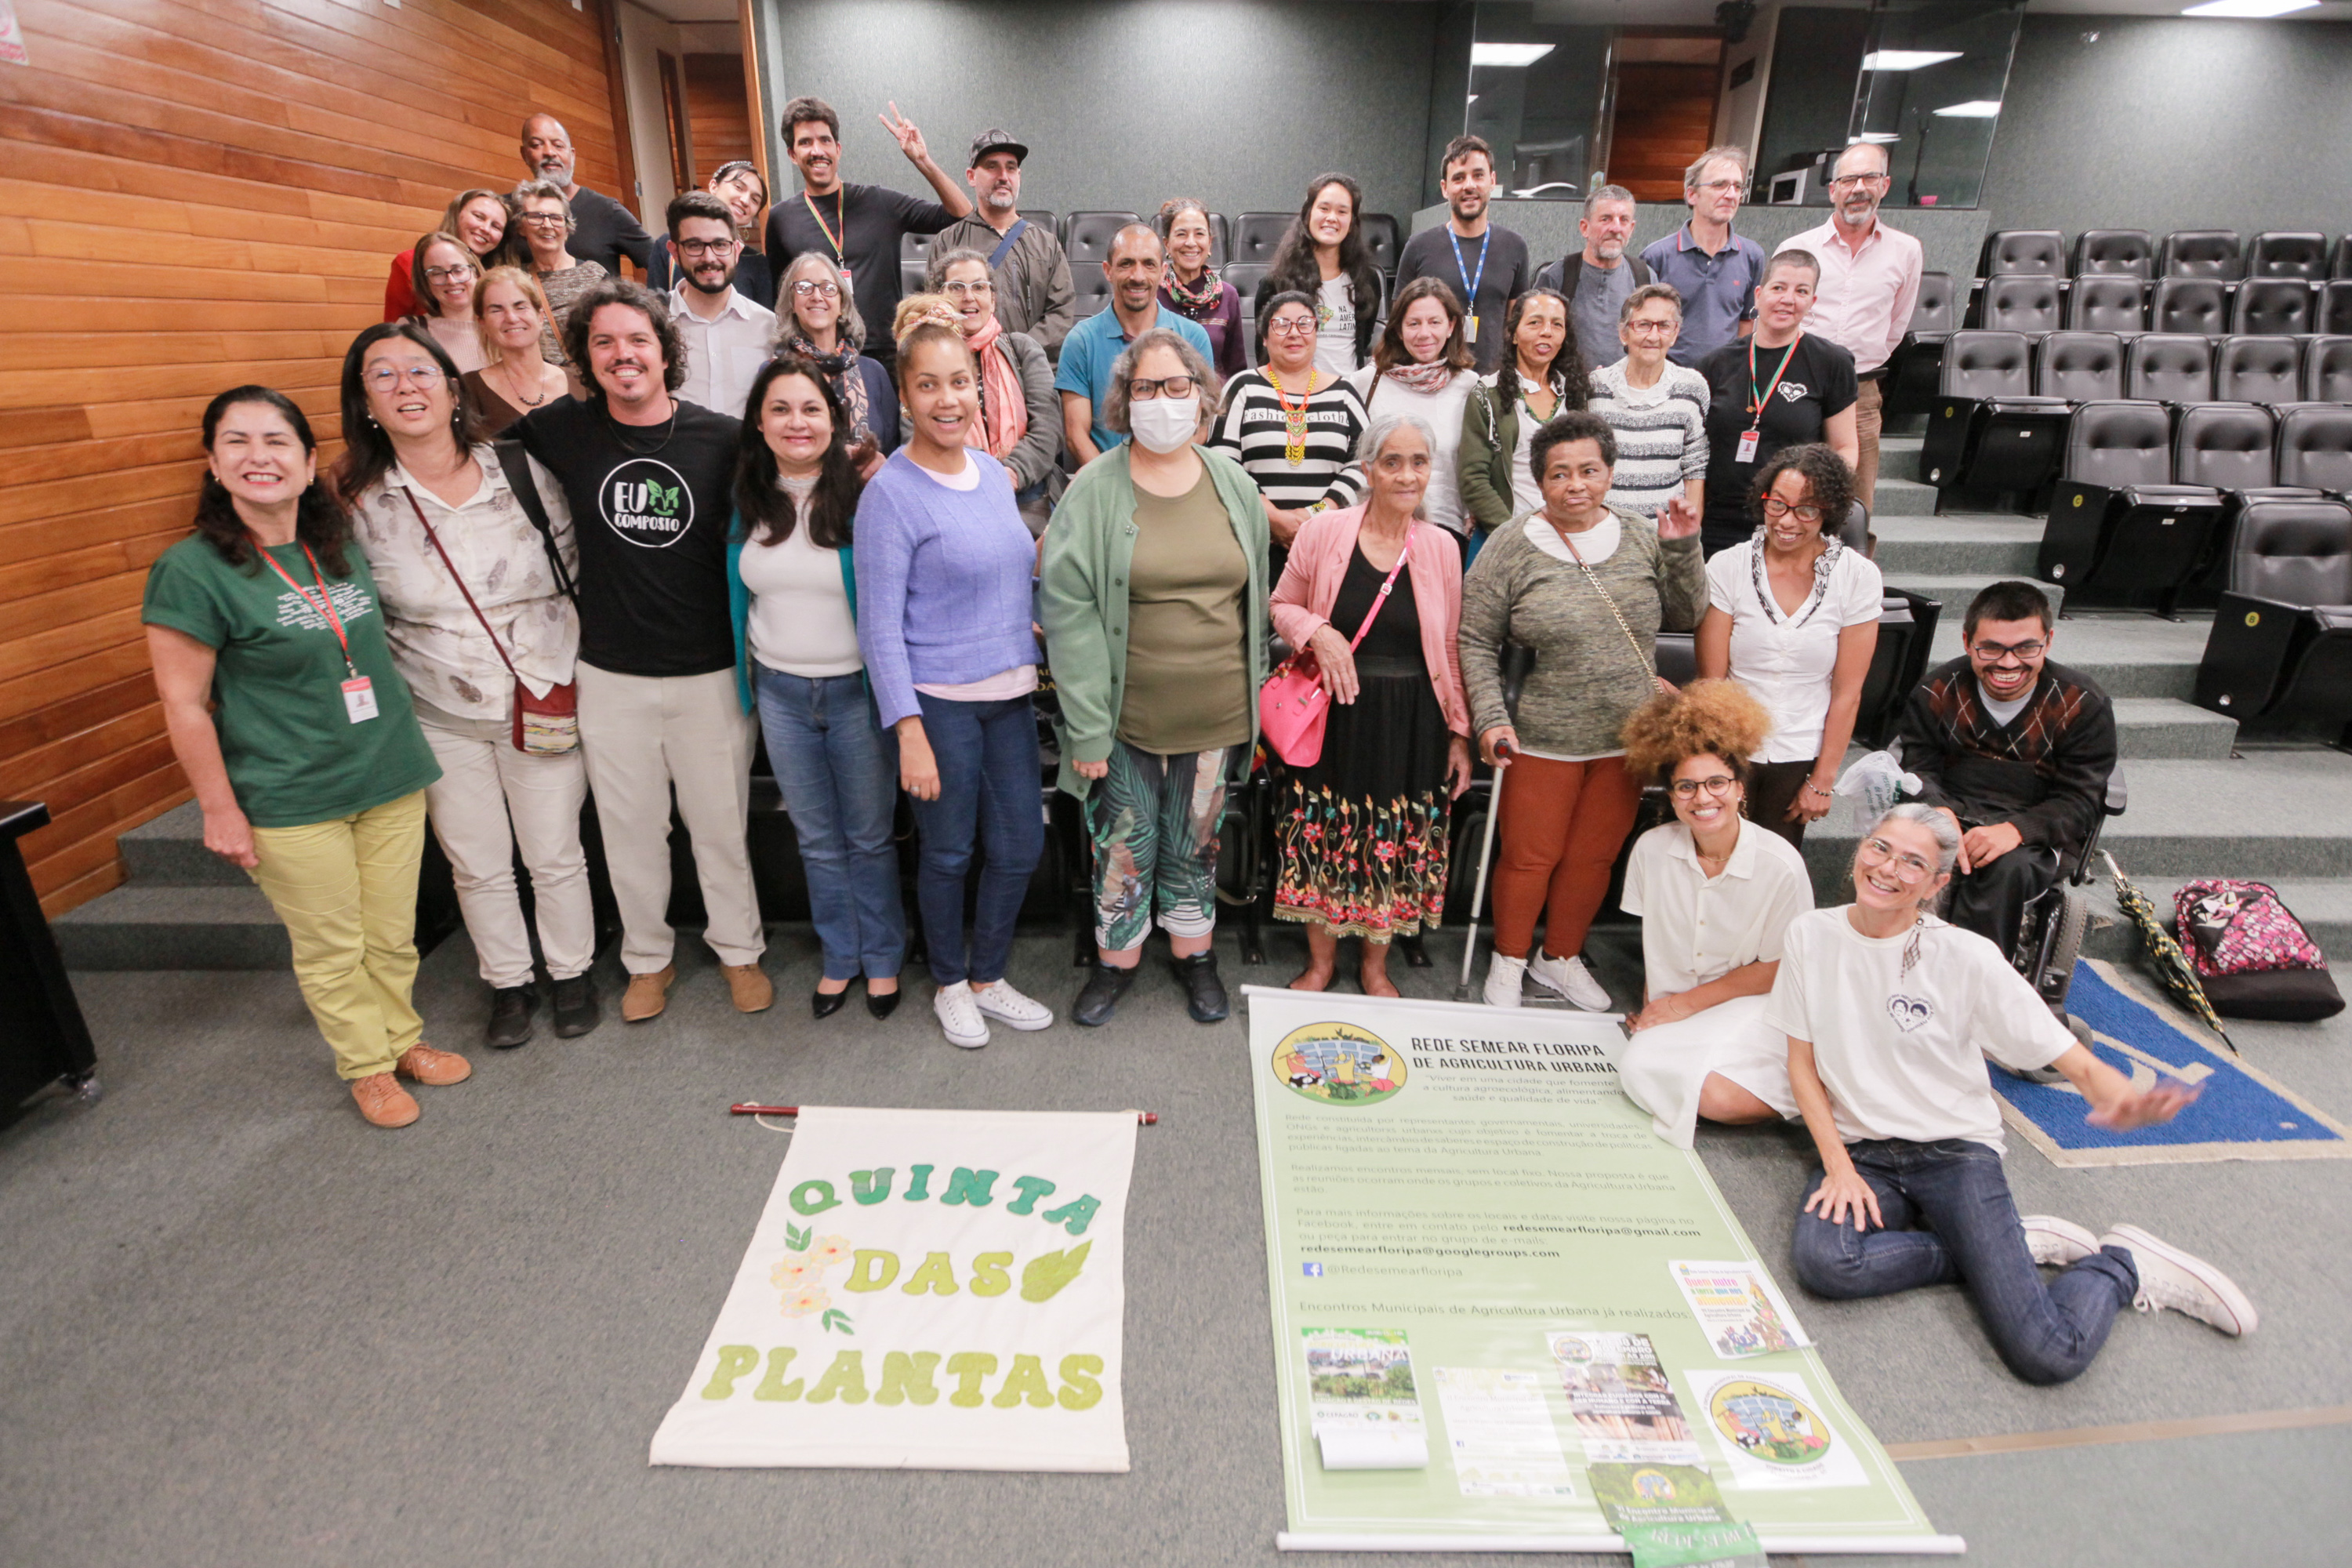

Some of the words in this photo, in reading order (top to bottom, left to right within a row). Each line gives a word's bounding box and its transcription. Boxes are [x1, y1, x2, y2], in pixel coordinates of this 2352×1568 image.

[1339, 311, 1356, 321] AMÉR
[615, 481, 648, 514] EU
[614, 513, 680, 532] COMPOSTO
[1411, 1037, 1456, 1052] REDE
[1460, 1040, 1530, 1055] SEMEAR
[1534, 1043, 1606, 1057] FLORIPA
[1414, 1057, 1435, 1069] DE
[1440, 1057, 1548, 1073] AGRICULTURA
[1551, 1062, 1619, 1074] URBANA
[1546, 1079, 1566, 1087] que
[1570, 1079, 1615, 1087] fomente
[1453, 1094, 1486, 1102] saúde
[1499, 1094, 1553, 1105] qualidade
[1555, 1087, 1624, 1097] alimentando
[1399, 1116, 1475, 1126] representantes
[1402, 1126, 1443, 1134] urbanxs
[1449, 1127, 1471, 1136] cujo
[1477, 1127, 1519, 1138] objetivo
[1537, 1129, 1584, 1138] fomentar
[1634, 1131, 1648, 1140] de
[1336, 1145, 1374, 1153] ligadas
[1441, 1146, 1499, 1156] Agricultura
[1290, 1163, 1354, 1173] Realizamos
[1357, 1165, 1413, 1174] encontros
[1493, 1167, 1519, 1177] local
[1548, 1170, 1582, 1179] Nossa
[1585, 1171, 1635, 1181] proposta
[1648, 1173, 1670, 1182] que
[1453, 1179, 1493, 1189] grupos
[1504, 1178, 1553, 1189] coletivos
[1571, 1181, 1632, 1192] Agricultura
[1634, 1182, 1676, 1192] Urbana
[789, 1164, 1101, 1236] QUINTA
[1297, 1208, 1322, 1217] Para
[1326, 1209, 1353, 1218] mais
[1432, 1210, 1465, 1220] sobre
[1484, 1211, 1518, 1221] locais
[1531, 1212, 1563, 1222] datas
[1566, 1214, 1595, 1223] visite
[1599, 1215, 1632, 1224] nossa
[1363, 1221, 1394, 1230] entre
[1422, 1223, 1468, 1232] contato
[1472, 1223, 1499, 1233] pelo
[1503, 1223, 1701, 1239] redesemearfloripa@gmail.com
[1319, 1234, 1347, 1243] peça
[1352, 1234, 1378, 1243] para
[1381, 1234, 1417, 1243] entrar
[1442, 1236, 1478, 1246] grupo
[1482, 1236, 1497, 1244] de
[1301, 1245, 1560, 1258] redesemearfloripa@googlegroups.com
[844, 1250, 1014, 1297] DAS
[1327, 1264, 1463, 1279] @Redesemearfloripa
[1684, 1277, 1712, 1287] Quem
[1712, 1278, 1739, 1287] nutre
[1300, 1301, 1367, 1312] Encontros
[1371, 1303, 1444, 1316] Municipais
[1449, 1305, 1466, 1315] de
[1471, 1305, 1546, 1317] Agricultura
[1549, 1306, 1599, 1316] Urbana
[1604, 1307, 1615, 1319] já
[1620, 1308, 1692, 1319] realizados:
[701, 1345, 1104, 1411] PLANTAS
